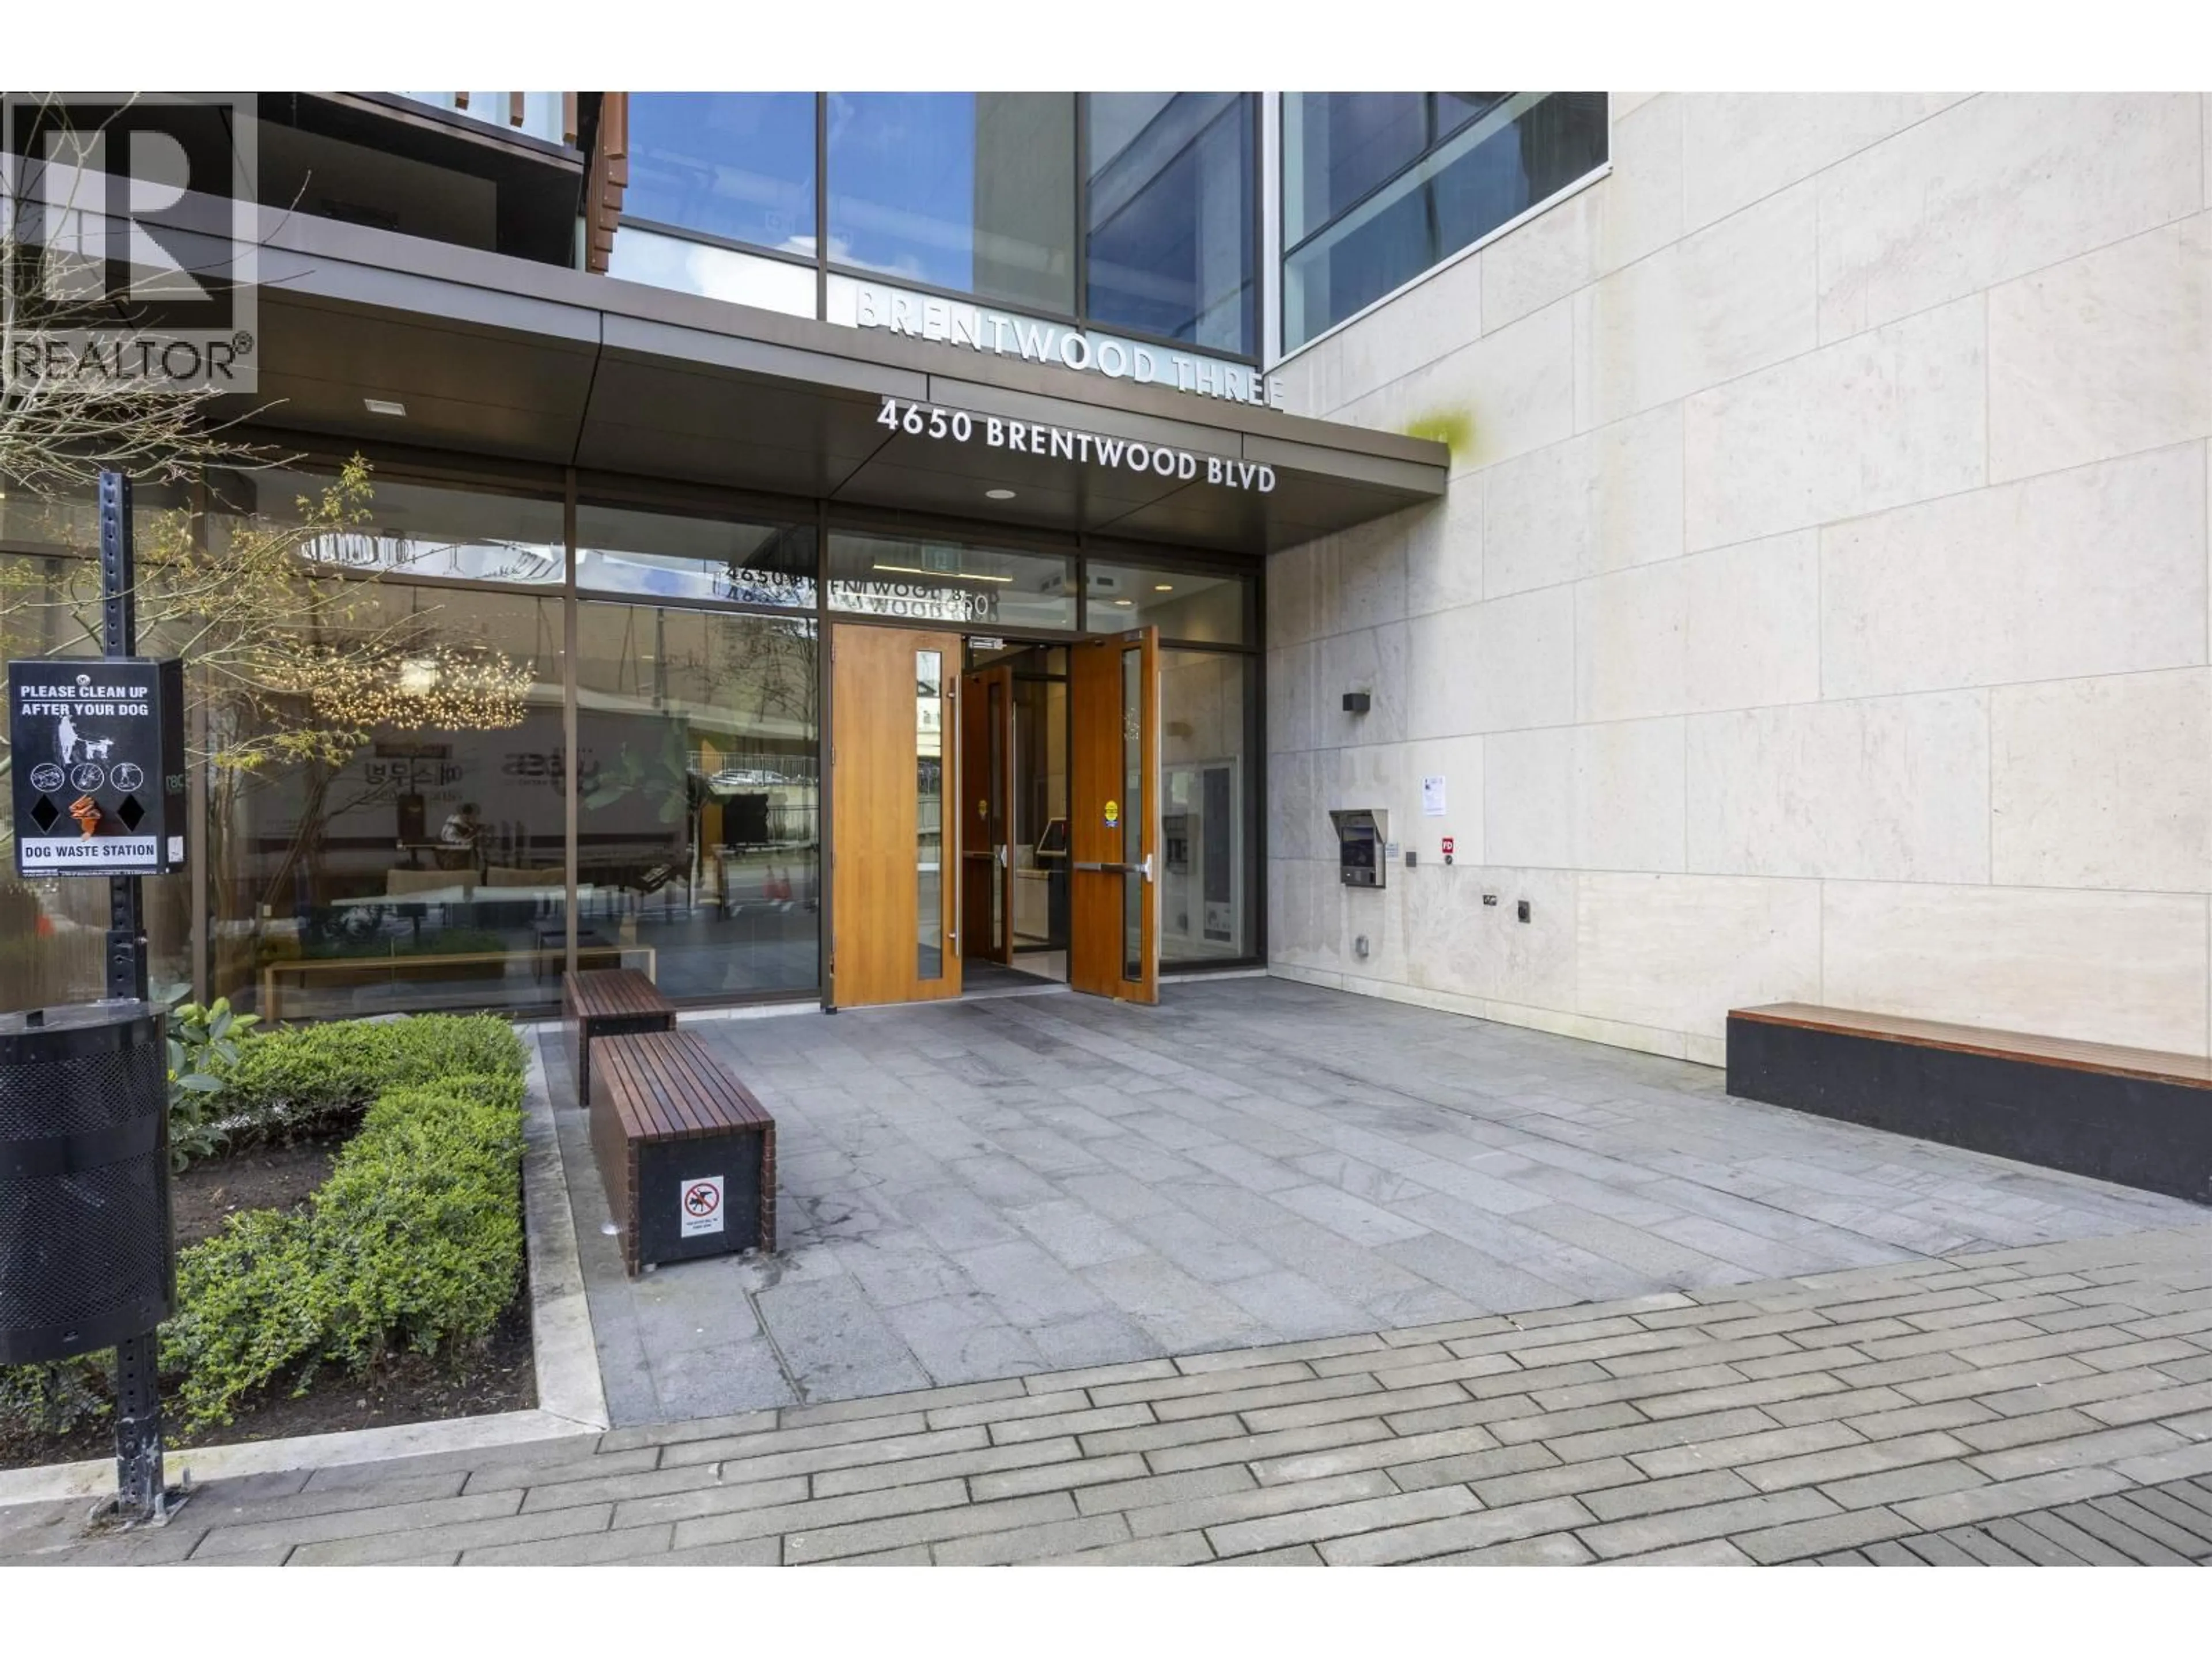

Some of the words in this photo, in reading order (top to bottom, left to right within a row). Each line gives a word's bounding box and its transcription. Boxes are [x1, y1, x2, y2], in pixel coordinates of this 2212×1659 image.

[857, 289, 1154, 382] BRENTWOOD
[1172, 355, 1283, 408] THREE
[877, 399, 972, 442] 4650
[987, 417, 1196, 480] BRENTWOOD
[1208, 457, 1276, 493] BLVD
[21, 685, 75, 698] PLEASE
[79, 685, 126, 698] CLEAN
[130, 686, 147, 698] UP
[22, 703, 70, 715] AFTER
[74, 703, 114, 716] YOUR
[119, 704, 149, 716] DOG
[26, 846, 51, 858] DOG
[56, 845, 99, 858] WASTE
[103, 844, 154, 857] STATION
